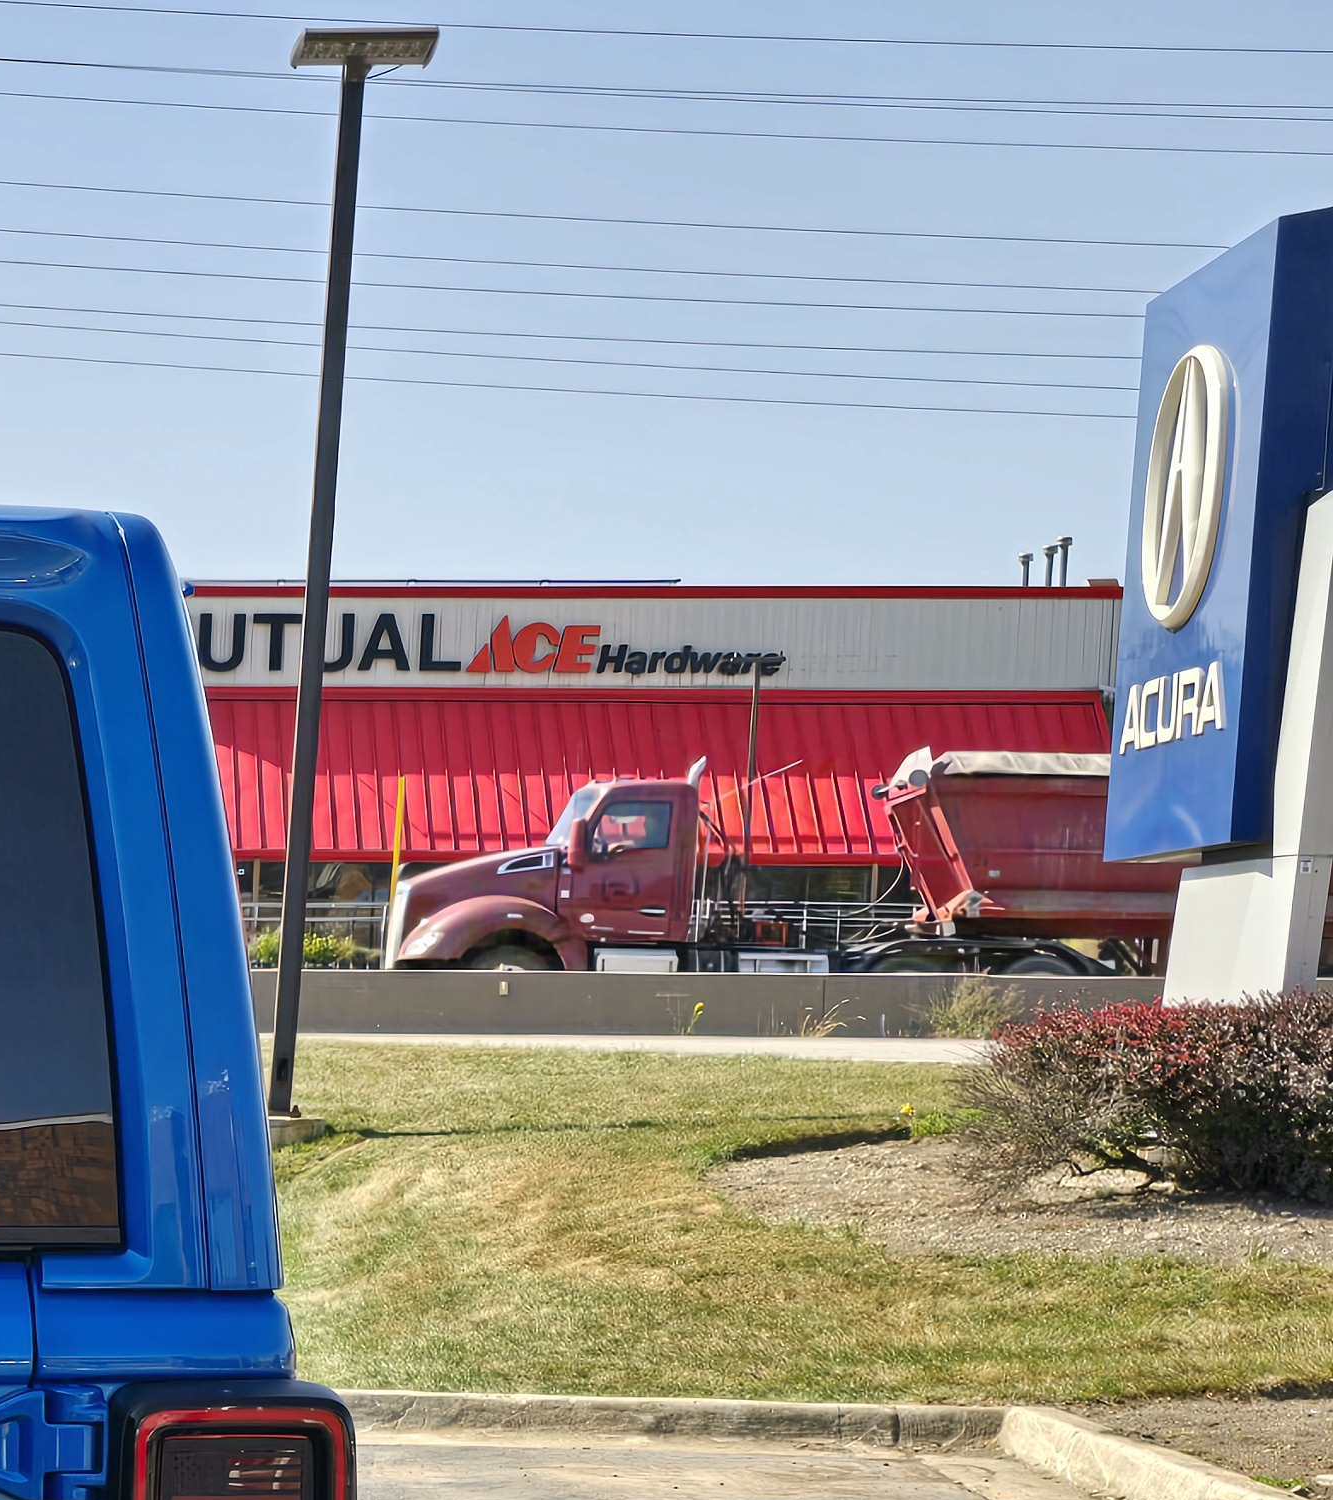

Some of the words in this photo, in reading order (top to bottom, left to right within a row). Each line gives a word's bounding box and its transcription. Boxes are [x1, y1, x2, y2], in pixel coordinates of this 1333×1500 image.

[466, 614, 601, 674] ACE
[596, 644, 786, 677] Hardware
[1119, 661, 1226, 755] ACURA
